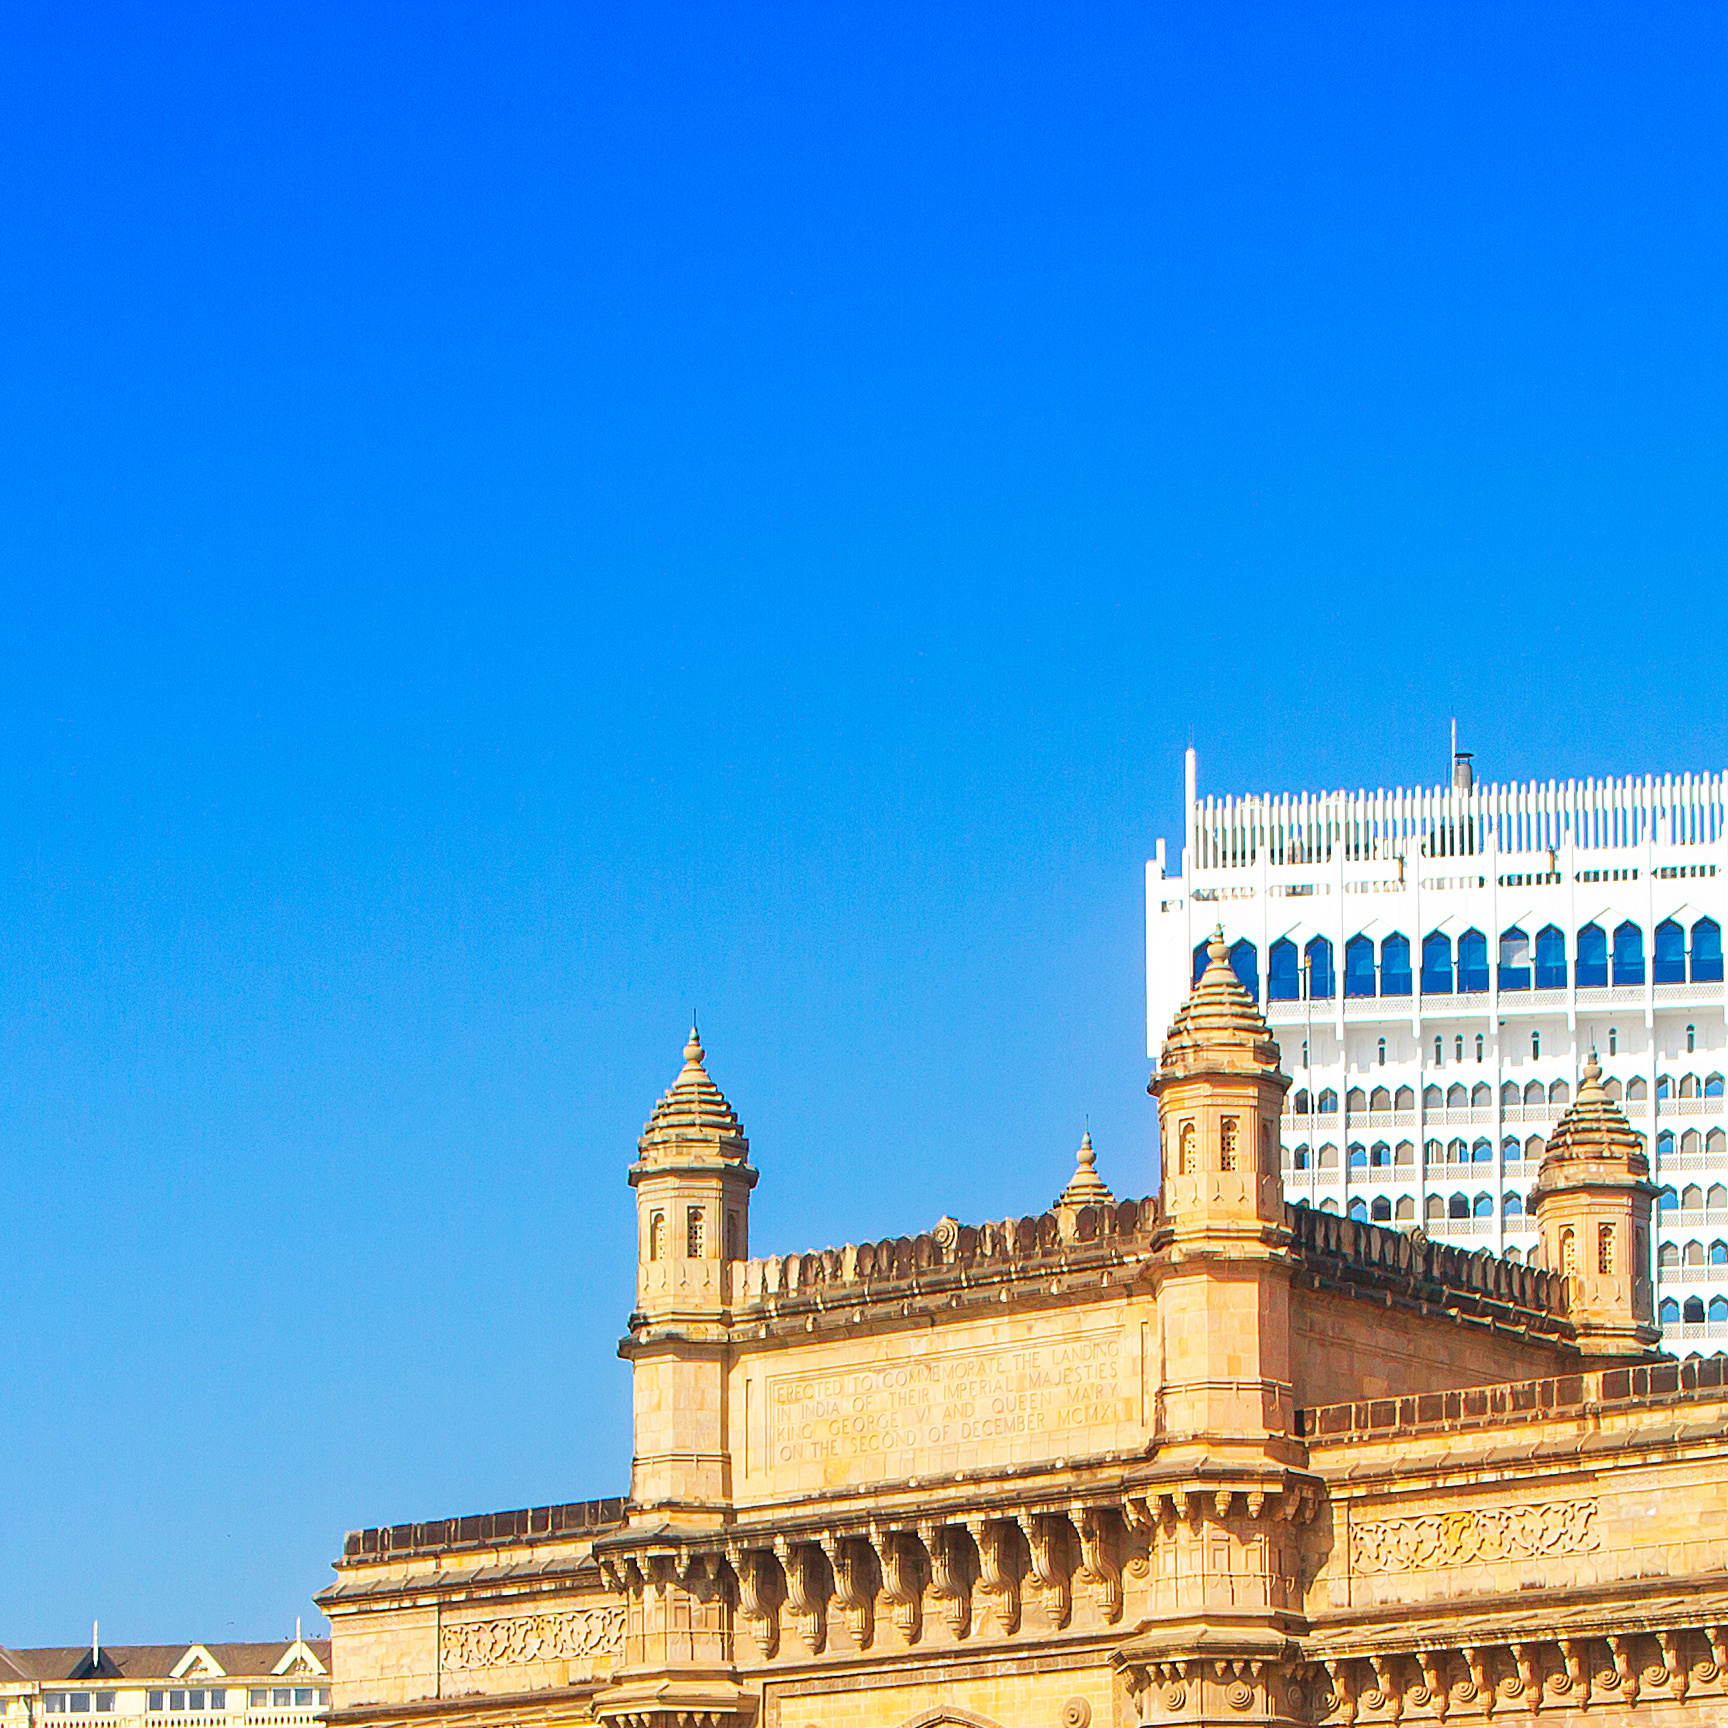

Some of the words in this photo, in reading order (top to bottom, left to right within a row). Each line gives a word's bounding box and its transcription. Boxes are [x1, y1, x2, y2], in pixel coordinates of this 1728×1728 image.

[777, 1379, 843, 1404] ERECTED
[852, 1374, 873, 1393] TO
[883, 1356, 1006, 1389] COMMEMORATE
[1013, 1351, 1041, 1371] THE
[1052, 1340, 1119, 1365] LANDING
[777, 1406, 791, 1423] IN
[802, 1401, 840, 1420] INDIA
[852, 1395, 873, 1413] OF
[888, 1387, 930, 1408] THEIR
[943, 1375, 1015, 1400] IMPERIAL
[1028, 1361, 1118, 1389] MAJESTIES
[777, 1423, 813, 1442] KING
[829, 1411, 899, 1436] GEORGE
[943, 1401, 975, 1421] AND
[991, 1390, 1052, 1414] QUEEN
[1067, 1382, 1119, 1403] MARY
[779, 1444, 804, 1462] ON
[811, 1439, 839, 1458] THE
[850, 1429, 917, 1453] SECOND
[928, 1424, 951, 1443] OF
[961, 1413, 1046, 1439] DECEMBER
[1057, 1402, 1118, 1427] MCMXI
